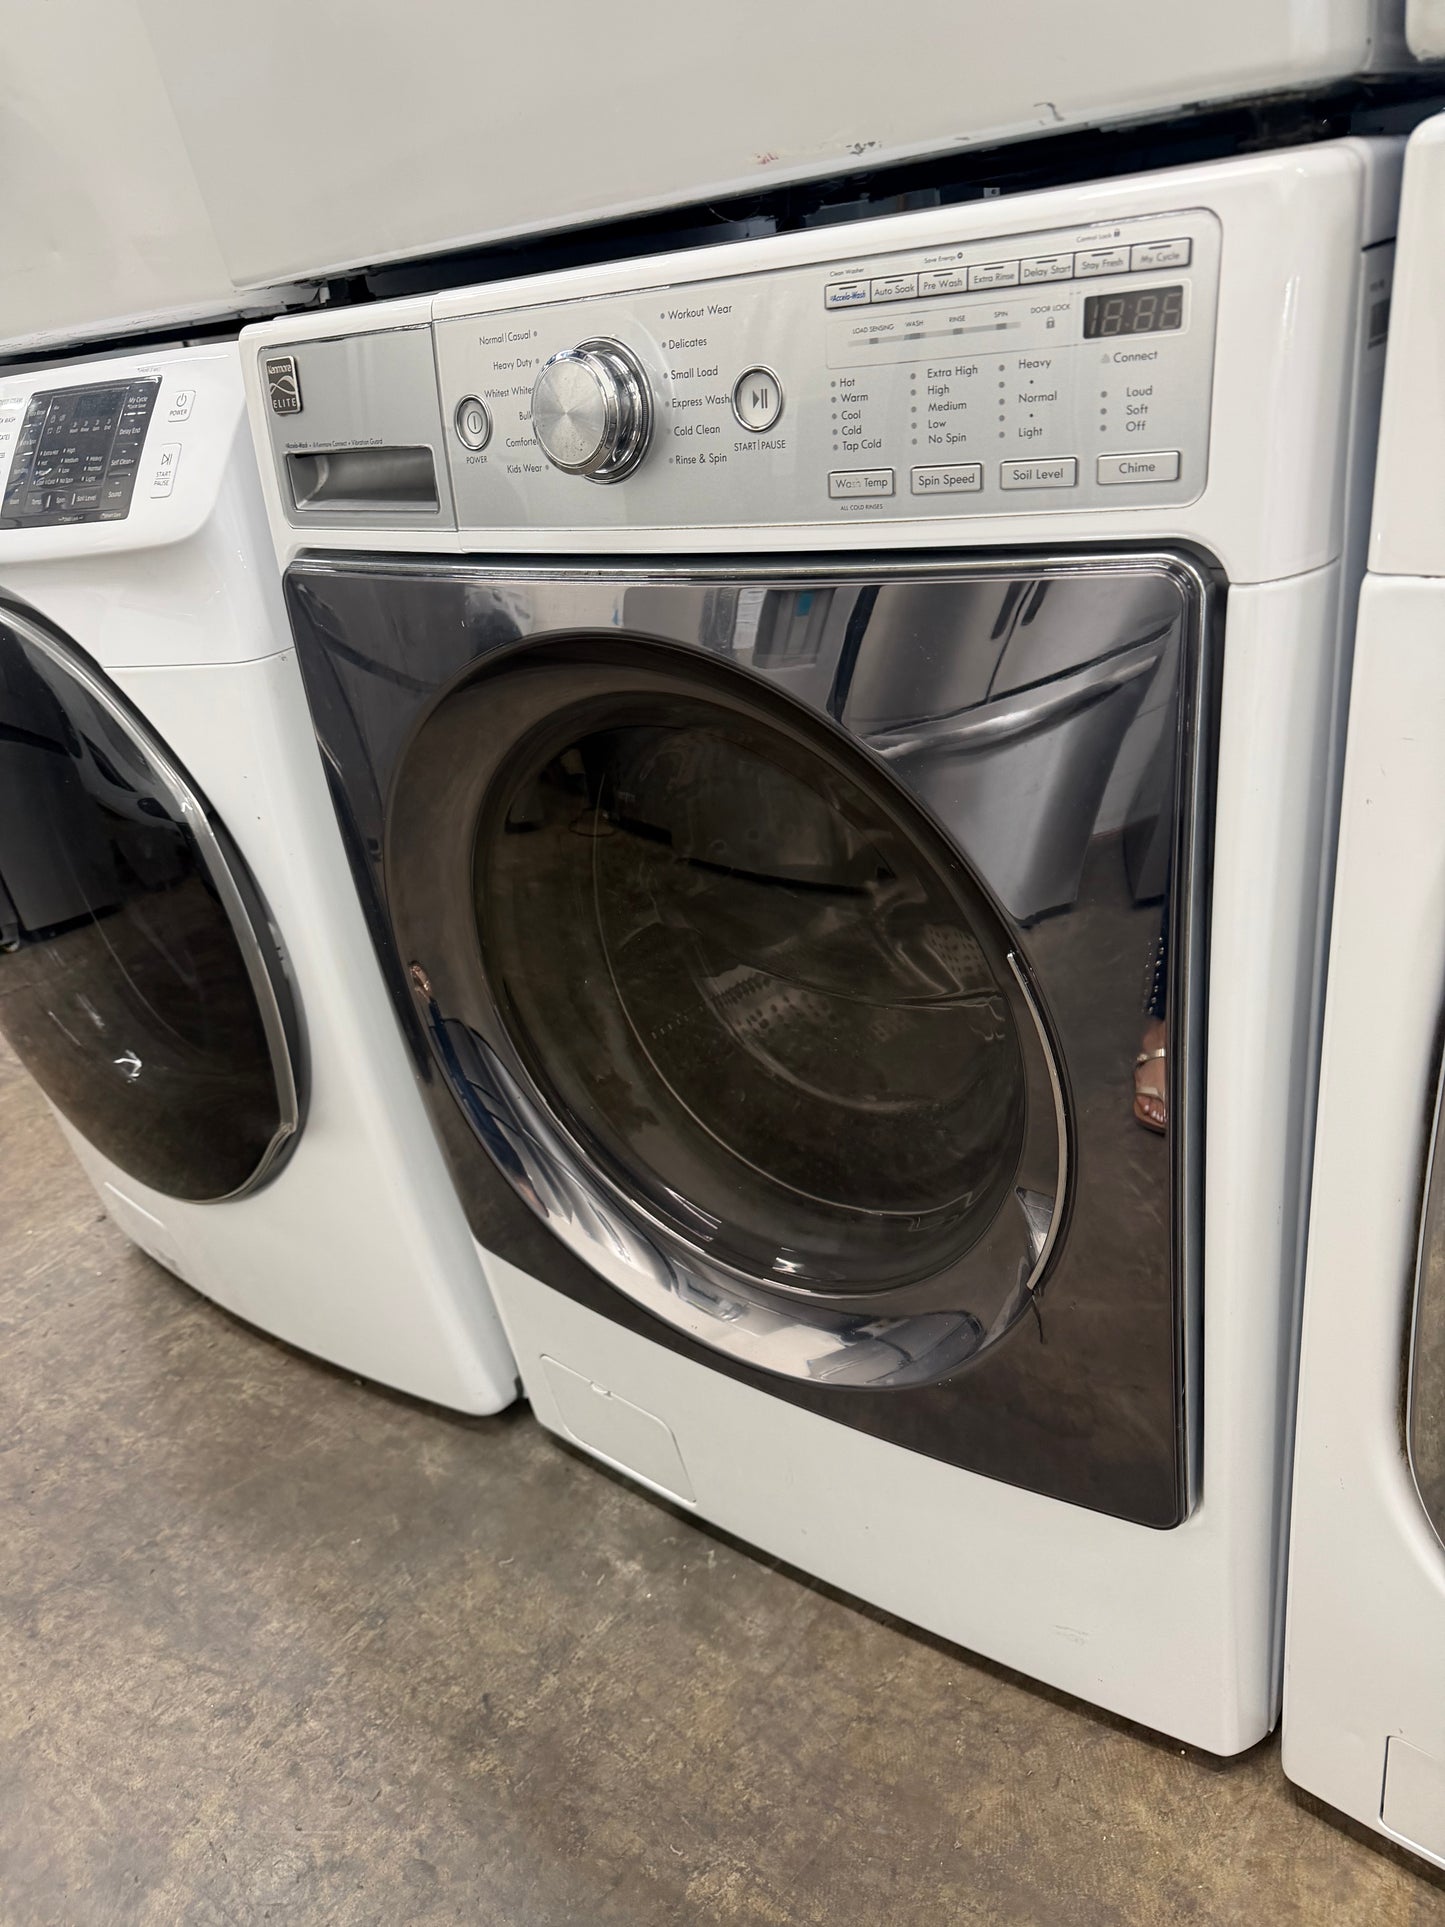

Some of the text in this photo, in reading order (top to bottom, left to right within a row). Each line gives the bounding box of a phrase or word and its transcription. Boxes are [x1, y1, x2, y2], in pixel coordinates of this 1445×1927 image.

[1141, 252, 1180, 263] My Cycle
[1082, 258, 1124, 270] Stay Fresh
[830, 269, 844, 277] Clean
[1024, 264, 1071, 278] Delay Start
[924, 278, 963, 290] Pre Wash
[974, 272, 1015, 284] Extra Rinse
[874, 284, 915, 296] Auto Soak
[668, 304, 733, 320] Workout Wear
[1030, 304, 1071, 314] DOOR LOCK
[904, 320, 924, 328] WASH
[949, 315, 966, 323] RINSE
[852, 324, 895, 335] LOAD SENSING
[668, 338, 708, 350] Delicates
[1113, 350, 1158, 364] Connect
[268, 364, 292, 375] Kenmore
[493, 358, 533, 371] Heavy Duty
[1018, 359, 1052, 371] Heavy
[670, 364, 719, 381] Small Load
[927, 364, 978, 379] Extra High
[840, 378, 856, 388] Hot
[484, 388, 510, 398] Whitest
[928, 384, 950, 397] High
[1126, 385, 1154, 398] Loud
[273, 398, 297, 409] ELITE
[672, 394, 731, 410] Express Wash
[841, 393, 869, 403] Warm
[1018, 391, 1058, 404] Normal
[170, 408, 188, 416] POWER
[928, 402, 968, 413] Medium
[1126, 404, 1149, 416] Soft
[841, 410, 862, 420] Cool
[674, 424, 721, 437] Cold Clean
[842, 425, 862, 436] Cold
[928, 420, 947, 429] Low
[1126, 421, 1147, 432] Off
[928, 432, 967, 445] No Spin
[1018, 427, 1043, 440] Light
[842, 439, 882, 452] Tap Cold
[466, 456, 488, 464] POWER
[676, 452, 728, 466] Rinse & Spin
[506, 464, 542, 474] Kids Wear
[1118, 462, 1156, 475] Chime
[918, 473, 975, 488] Spin Speed
[1012, 468, 1064, 482] Soil Level
[835, 478, 888, 489] Wa Temp
